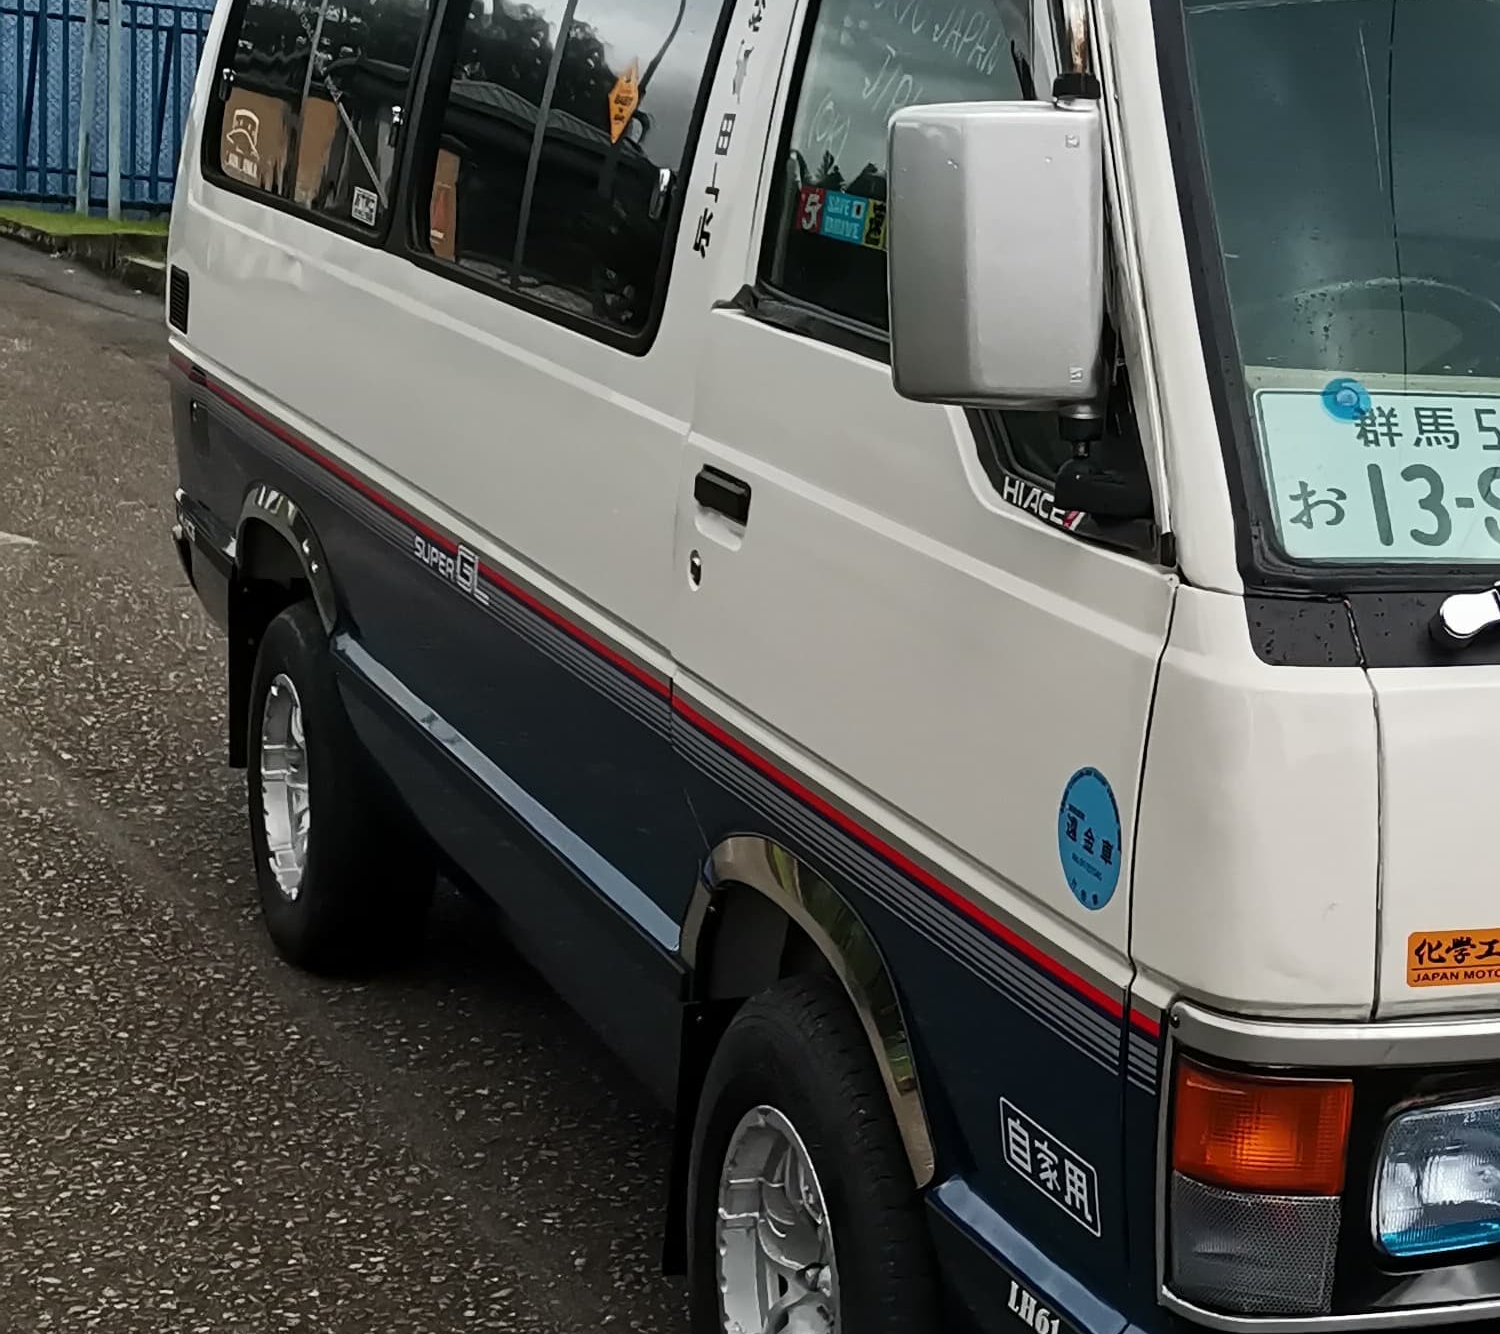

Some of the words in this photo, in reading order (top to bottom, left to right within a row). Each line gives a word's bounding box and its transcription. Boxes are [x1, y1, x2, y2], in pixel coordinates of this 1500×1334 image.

[1003, 475, 1066, 527] HIACE
[1288, 480, 1347, 530] お
[414, 535, 455, 583] SUPER
[1413, 970, 1459, 983] JAPAN
[1007, 1117, 1093, 1224] 自家用
